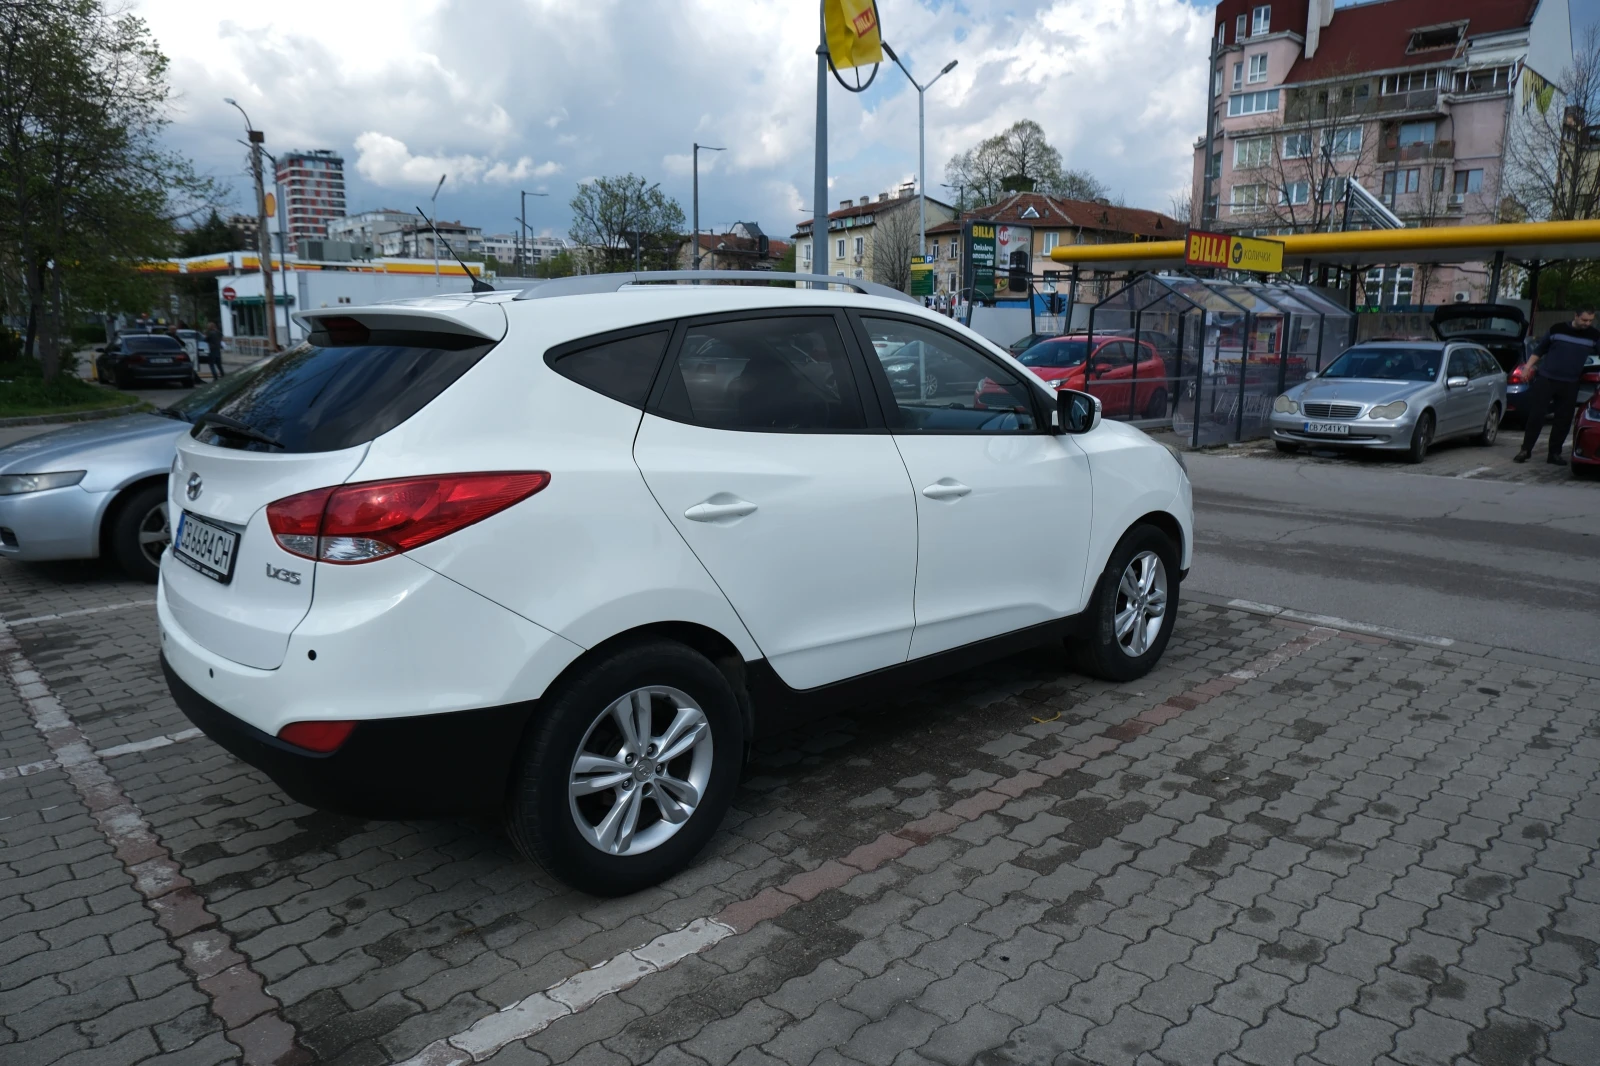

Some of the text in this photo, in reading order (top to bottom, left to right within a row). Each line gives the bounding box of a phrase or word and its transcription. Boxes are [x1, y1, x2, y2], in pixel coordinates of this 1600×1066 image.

[972, 225, 995, 238] BILLA
[1189, 234, 1227, 264] BILLA
[1243, 249, 1271, 262] КОЛИЧКИ
[926, 255, 933, 263] P
